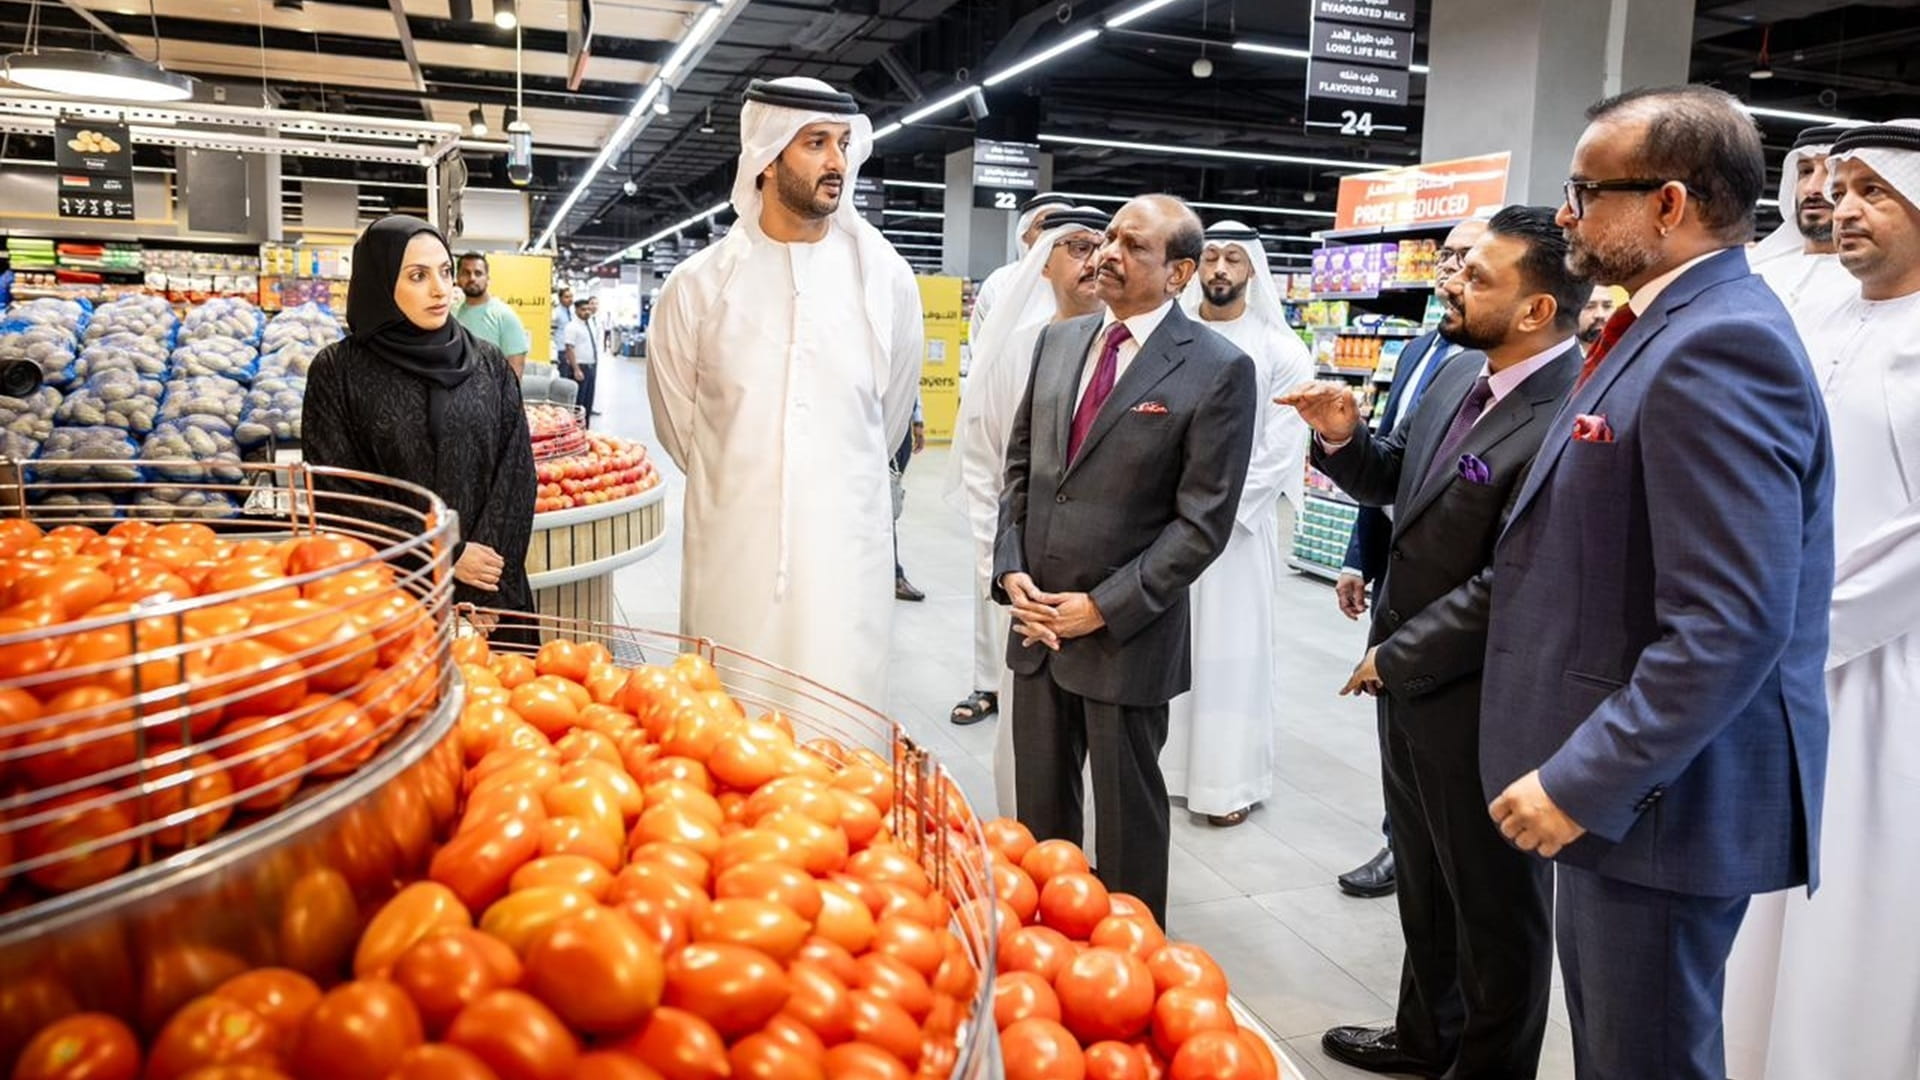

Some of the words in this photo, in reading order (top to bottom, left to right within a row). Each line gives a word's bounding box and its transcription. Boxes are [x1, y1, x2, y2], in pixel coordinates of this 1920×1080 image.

[1321, 2, 1382, 18] EVAPORATED
[1383, 10, 1406, 21] MILK
[1326, 42, 1352, 54] LONG
[1353, 45, 1373, 57] LIFE
[1374, 48, 1397, 60] MILK
[1319, 81, 1373, 96] FLAVOURED
[1374, 87, 1397, 98] MILK
[1340, 110, 1373, 136] 24
[995, 192, 1016, 209] 22
[1354, 202, 1393, 224] PRICE
